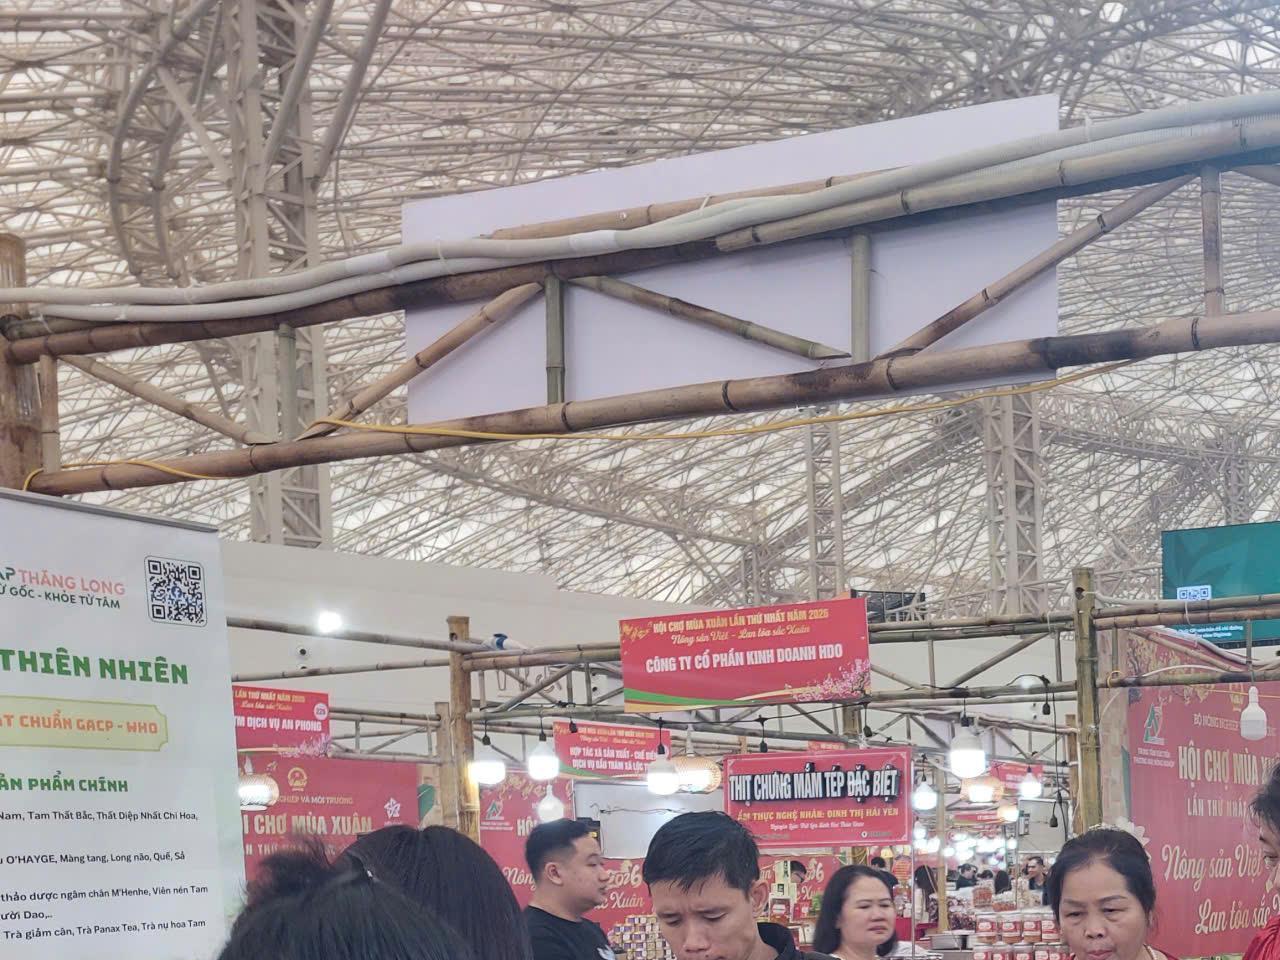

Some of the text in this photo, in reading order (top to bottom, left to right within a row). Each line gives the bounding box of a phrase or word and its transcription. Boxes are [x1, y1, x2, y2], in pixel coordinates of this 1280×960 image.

[18, 568, 77, 591] THĂNG
[80, 575, 126, 596] LONG
[9, 583, 121, 610] GỐC KHỎE TỪ TÂM
[0, 646, 189, 685] THIÊN NHIÊN
[646, 643, 844, 673] CÔNG TY CỔ PHẦN KINH DOANH HDO
[19, 707, 73, 731] CHUẨN
[76, 717, 114, 733] GACP
[126, 720, 158, 735] WHO
[281, 718, 294, 730] AN
[295, 719, 323, 732] PHONG
[1178, 739, 1201, 789] HỘI
[1204, 748, 1230, 791] CHỢ
[1233, 747, 1259, 786] MÙA
[28, 770, 129, 793] PHẨM CHÍNH
[729, 774, 753, 807] THỊT
[793, 762, 823, 800] MẮM
[824, 764, 845, 798] TÉP
[847, 764, 871, 804] ĐẶC
[872, 763, 899, 804] BIỆT
[28, 811, 51, 820] Tam
[52, 809, 75, 820] Thất
[96, 809, 118, 820] Thất
[119, 810, 139, 822] Diệp
[140, 809, 163, 820] Nhất
[163, 810, 178, 820] Chi
[1187, 792, 1204, 817] LẦN
[291, 810, 328, 836] MÙA
[331, 811, 373, 836] XUÂN
[60, 853, 86, 864] Màng
[110, 852, 132, 863] Long
[1161, 844, 1205, 892] Nông
[1208, 849, 1233, 879] sản
[190, 884, 209, 894] Tam
[1195, 898, 1227, 935] Lan
[1229, 900, 1251, 930] tỏa
[1252, 894, 1271, 929] sắc
[4, 929, 23, 939] Trà
[25, 927, 52, 941] giảm
[77, 924, 93, 935] Trà
[94, 923, 121, 934] Panax
[141, 920, 156, 931] Trà
[170, 919, 187, 929] hoa
[187, 918, 207, 928] Tam
